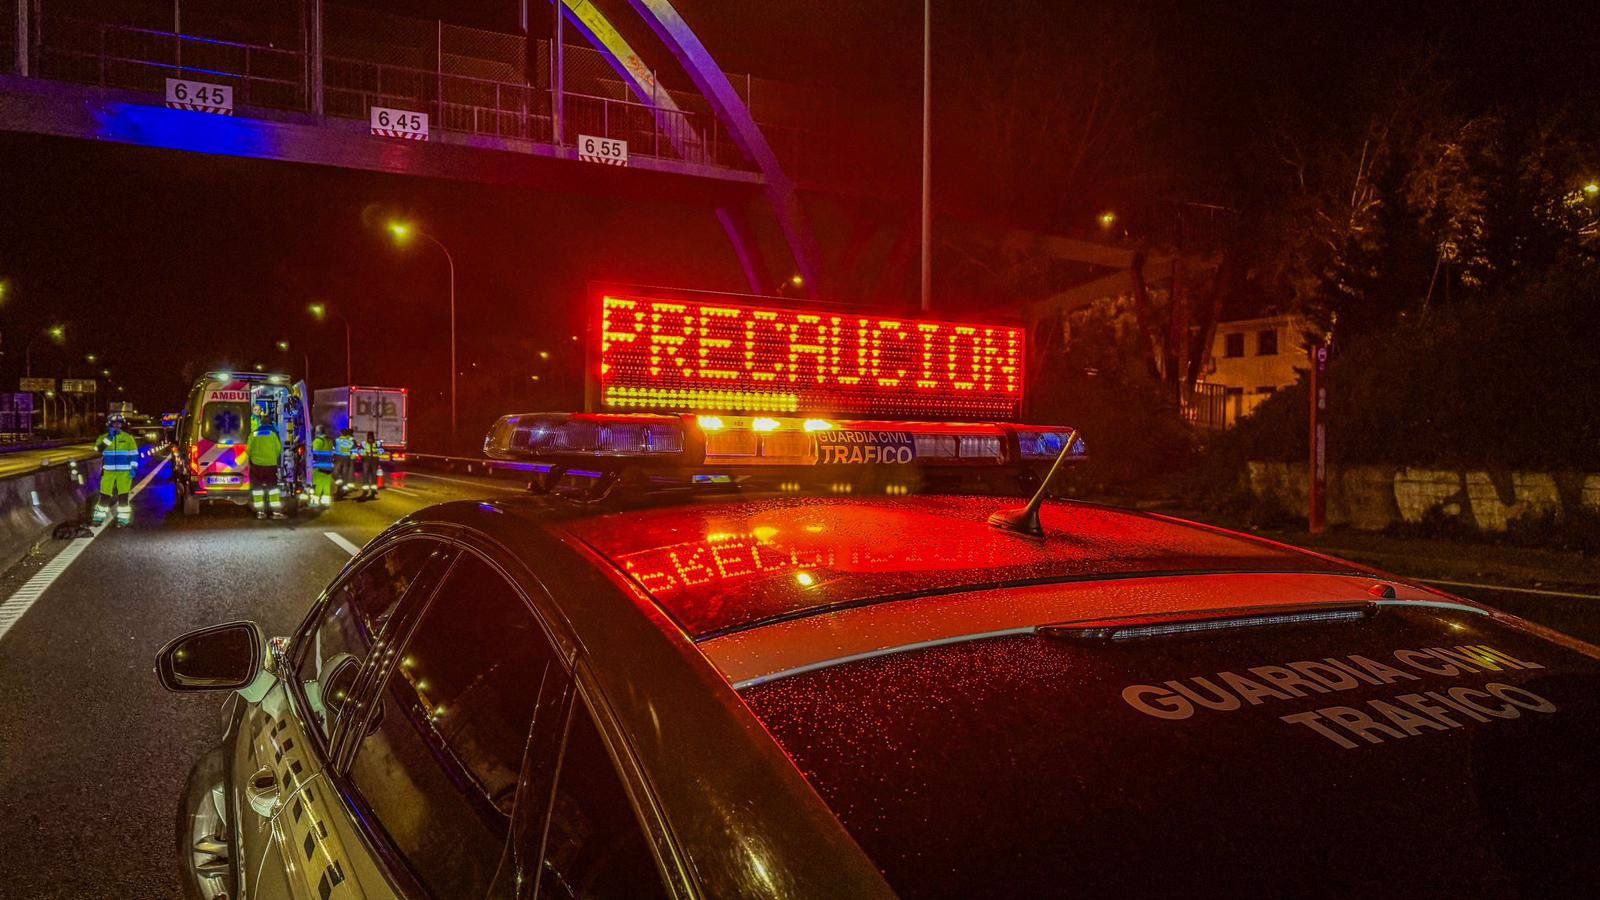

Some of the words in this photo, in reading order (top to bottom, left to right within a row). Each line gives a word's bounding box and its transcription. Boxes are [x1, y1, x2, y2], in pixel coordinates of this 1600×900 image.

[175, 83, 224, 105] 6,45
[379, 111, 421, 131] 6,45
[586, 139, 621, 157] 6,55
[602, 296, 1016, 392] PRECAUCION
[819, 431, 878, 443] GUARDIA
[879, 431, 912, 444] CIVIL
[820, 445, 913, 464] TRAFICO
[1121, 654, 1422, 720] GUARDIA
[1394, 645, 1546, 677] CIVIL
[1279, 682, 1557, 750] TRAFICO
